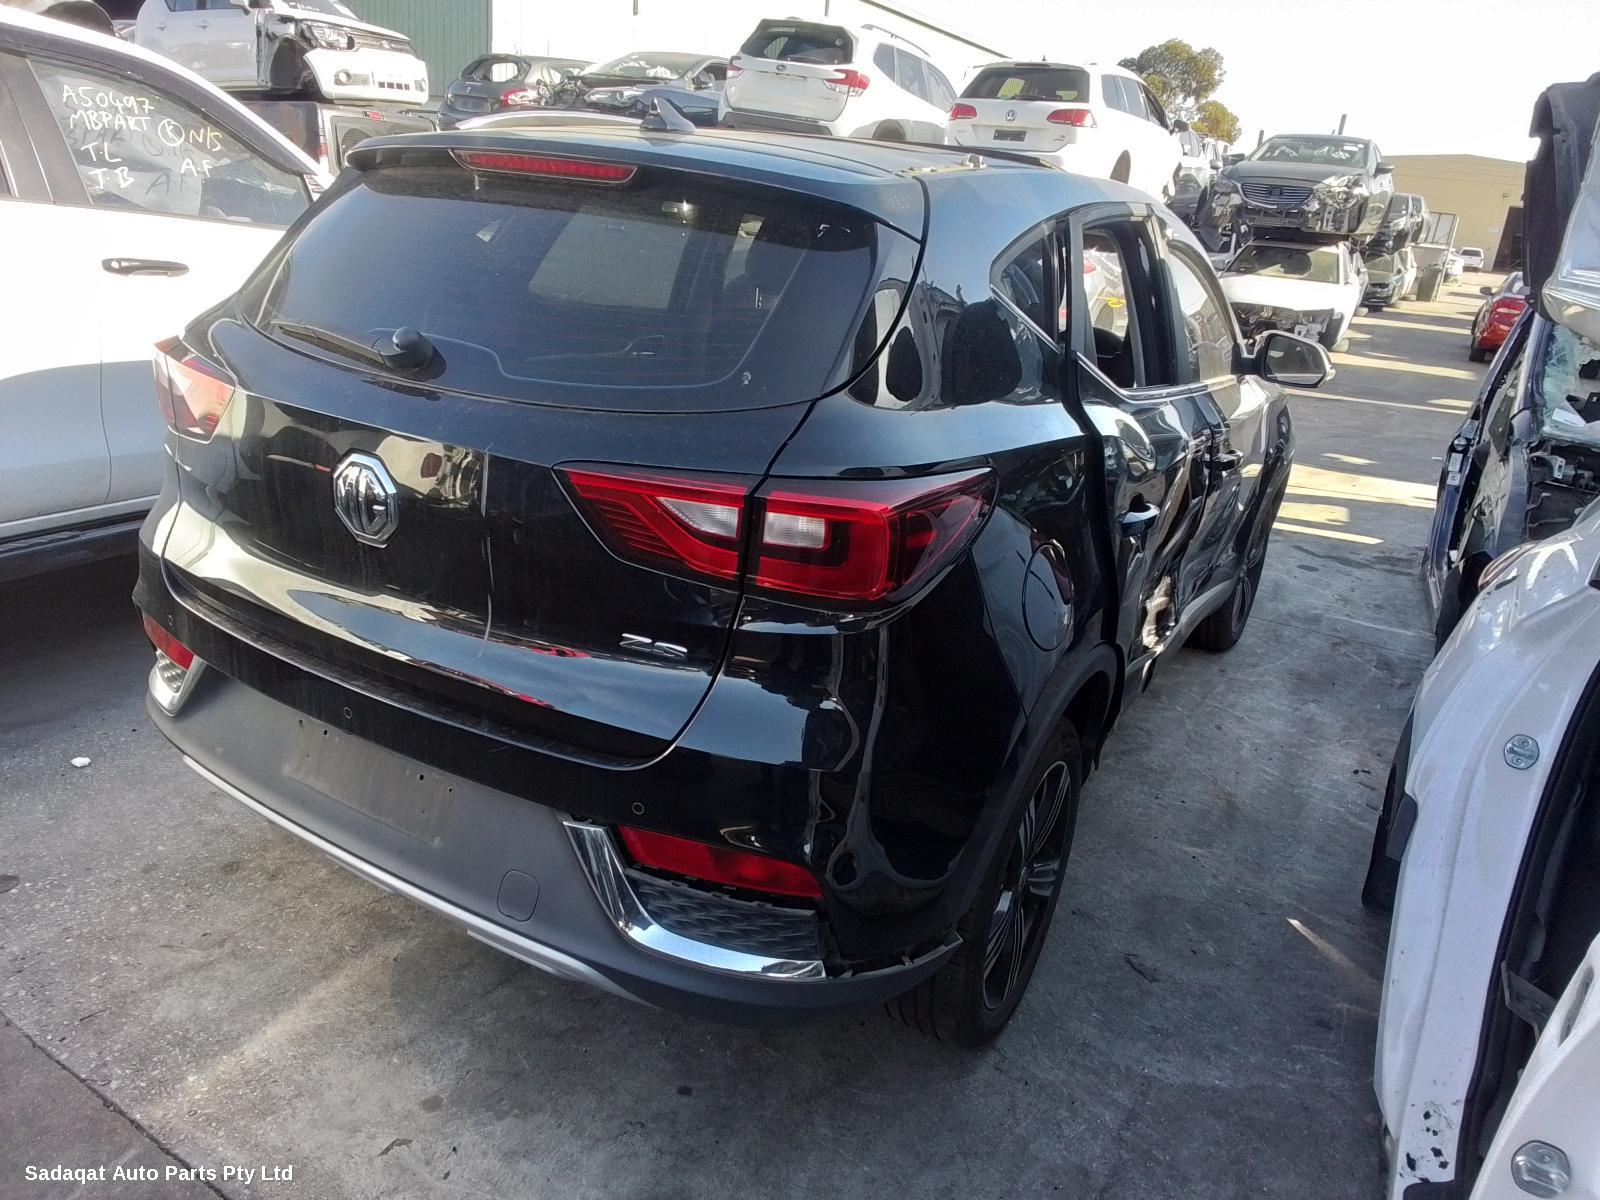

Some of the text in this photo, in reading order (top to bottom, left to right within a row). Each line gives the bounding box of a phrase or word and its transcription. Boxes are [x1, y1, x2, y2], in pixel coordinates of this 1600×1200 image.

[70, 110, 150, 131] MBPART
[336, 465, 388, 536] MG
[619, 633, 688, 659] ZS
